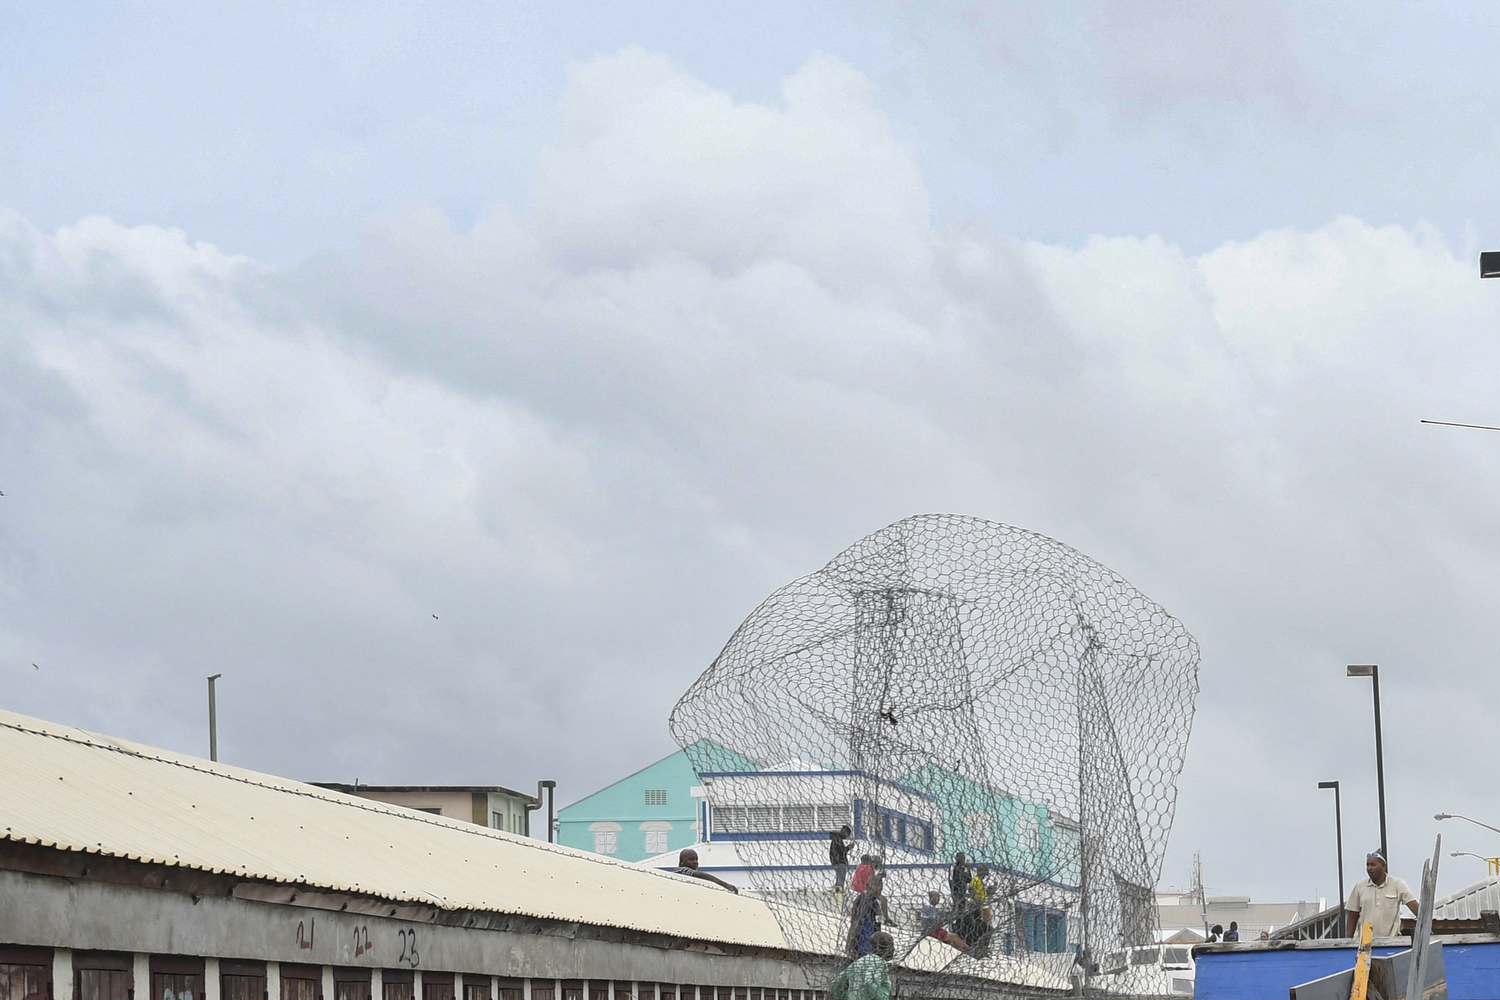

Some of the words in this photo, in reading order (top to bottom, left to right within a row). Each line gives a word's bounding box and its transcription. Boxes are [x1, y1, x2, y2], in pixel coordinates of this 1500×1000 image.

[296, 917, 315, 951] 21
[353, 924, 373, 958] 22
[398, 928, 420, 969] 23
